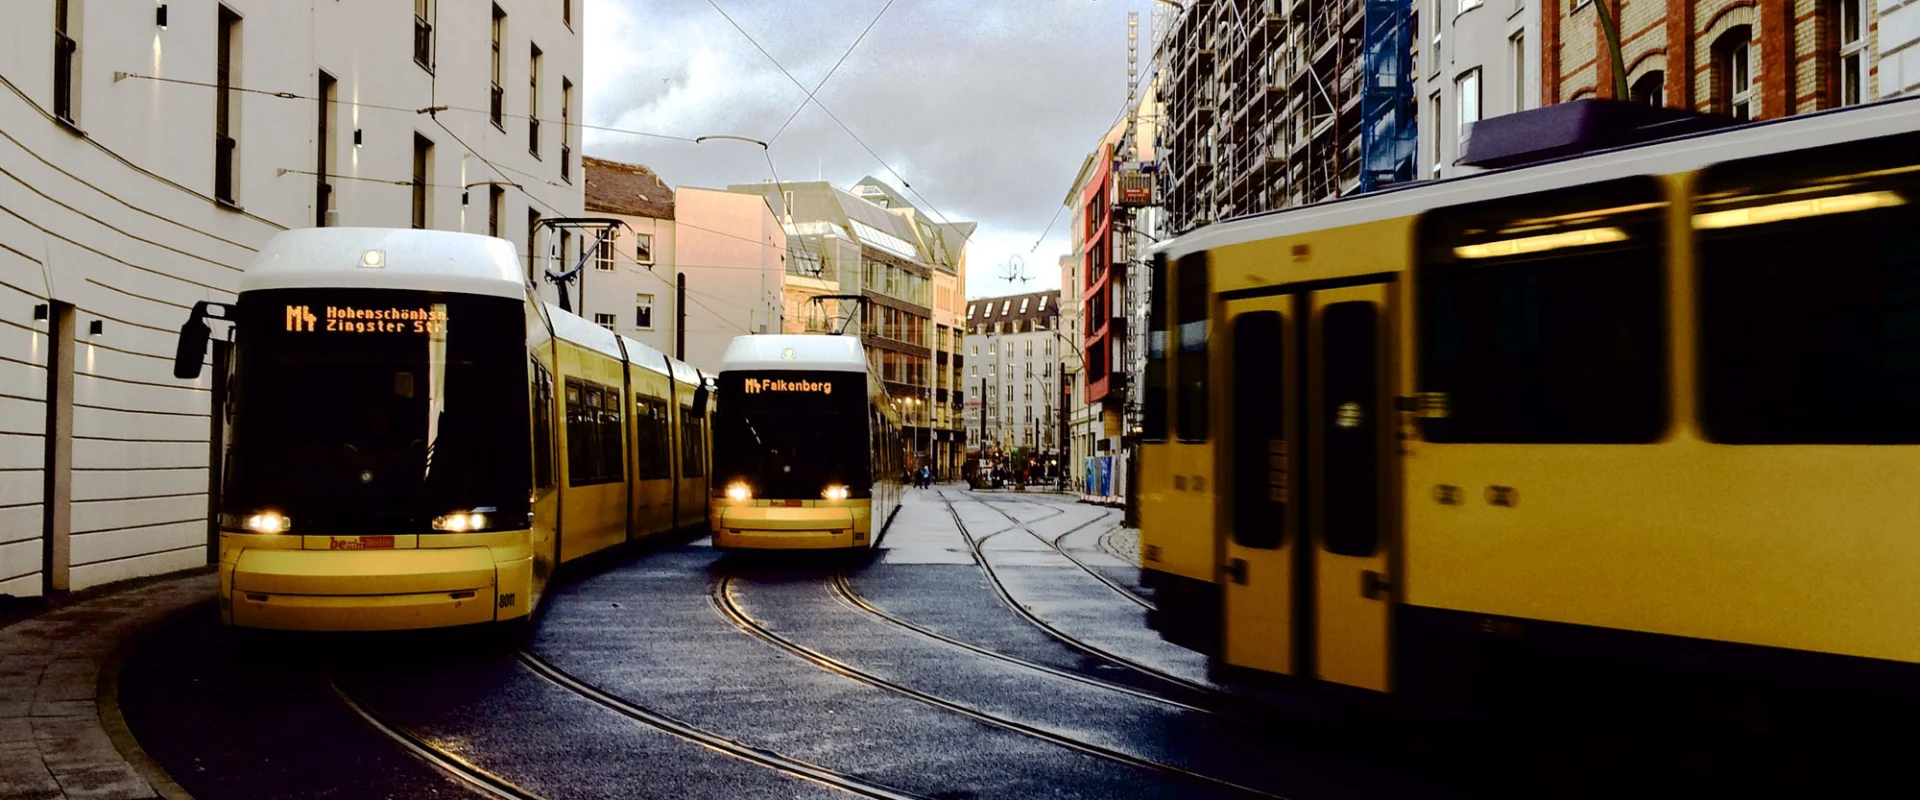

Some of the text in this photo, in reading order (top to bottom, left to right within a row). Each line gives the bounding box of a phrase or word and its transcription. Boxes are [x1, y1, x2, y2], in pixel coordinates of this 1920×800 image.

[286, 305, 317, 332] M4
[326, 319, 405, 333] Zingster
[762, 379, 832, 394] Falkenberg
